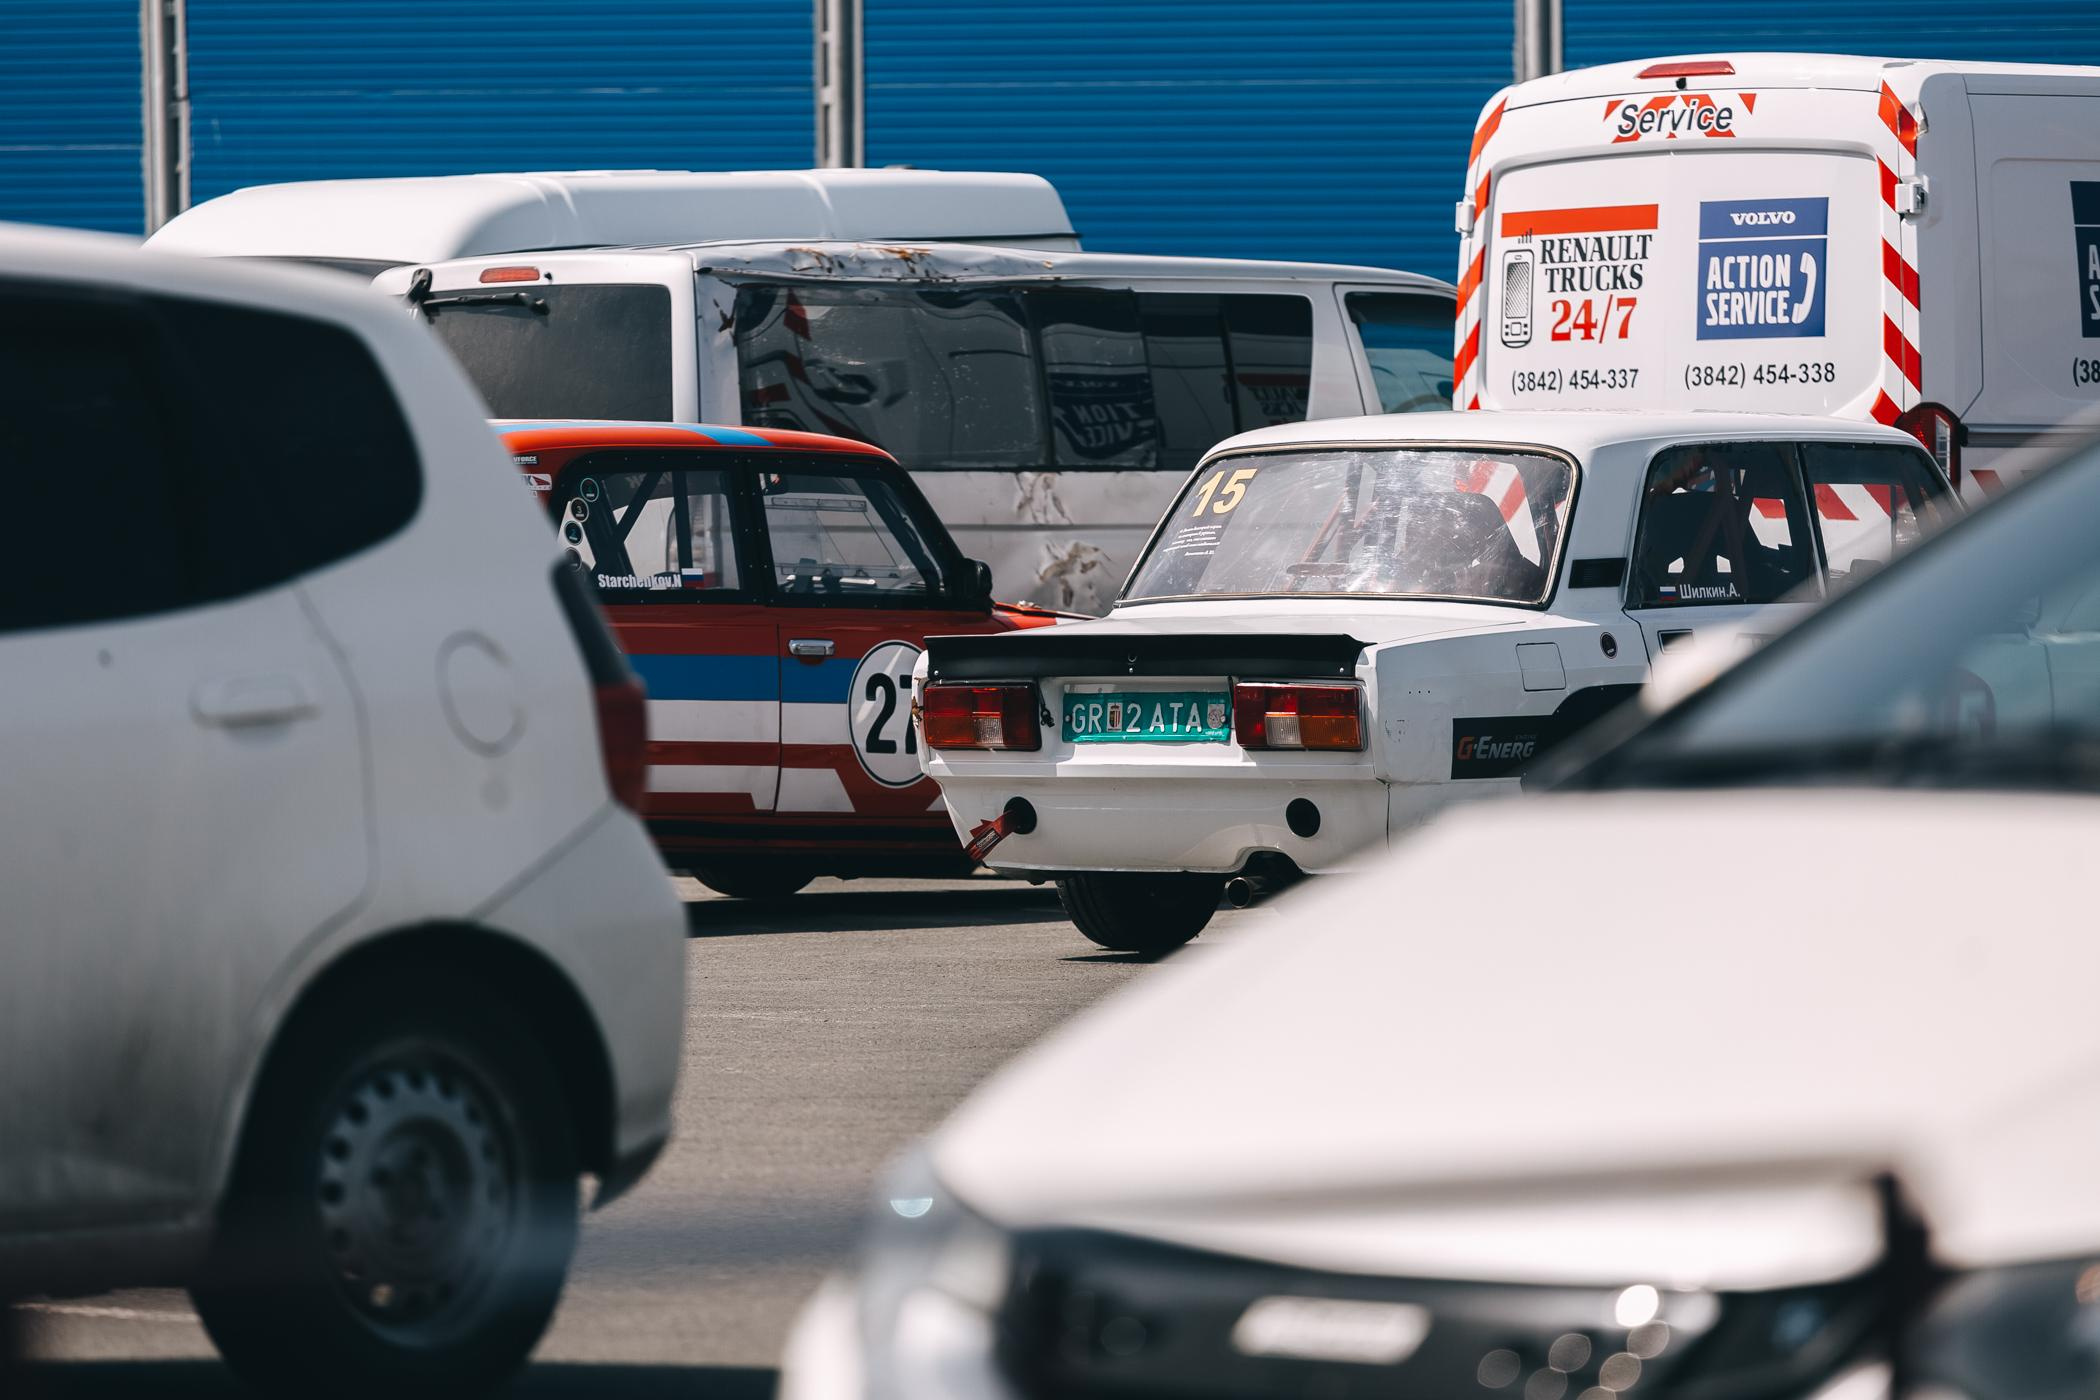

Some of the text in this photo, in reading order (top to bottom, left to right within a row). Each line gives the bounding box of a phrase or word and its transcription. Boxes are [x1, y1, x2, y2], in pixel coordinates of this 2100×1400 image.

[1618, 101, 1733, 134] Service
[1730, 211, 1796, 225] VOLVO
[1540, 234, 1653, 264] RENAULT
[1545, 264, 1643, 293] TRUCKS
[1706, 254, 1791, 290] ACTION
[1551, 294, 1637, 344] 24/7
[1706, 290, 1790, 326] SERVICE
[1512, 368, 1639, 395] (3842) 454-337
[1685, 362, 1835, 390] (3842) 454-338
[1192, 468, 1258, 517] 15
[1680, 582, 1741, 599] Шилкин.А.
[1072, 702, 1202, 733] GR 2 ATA
